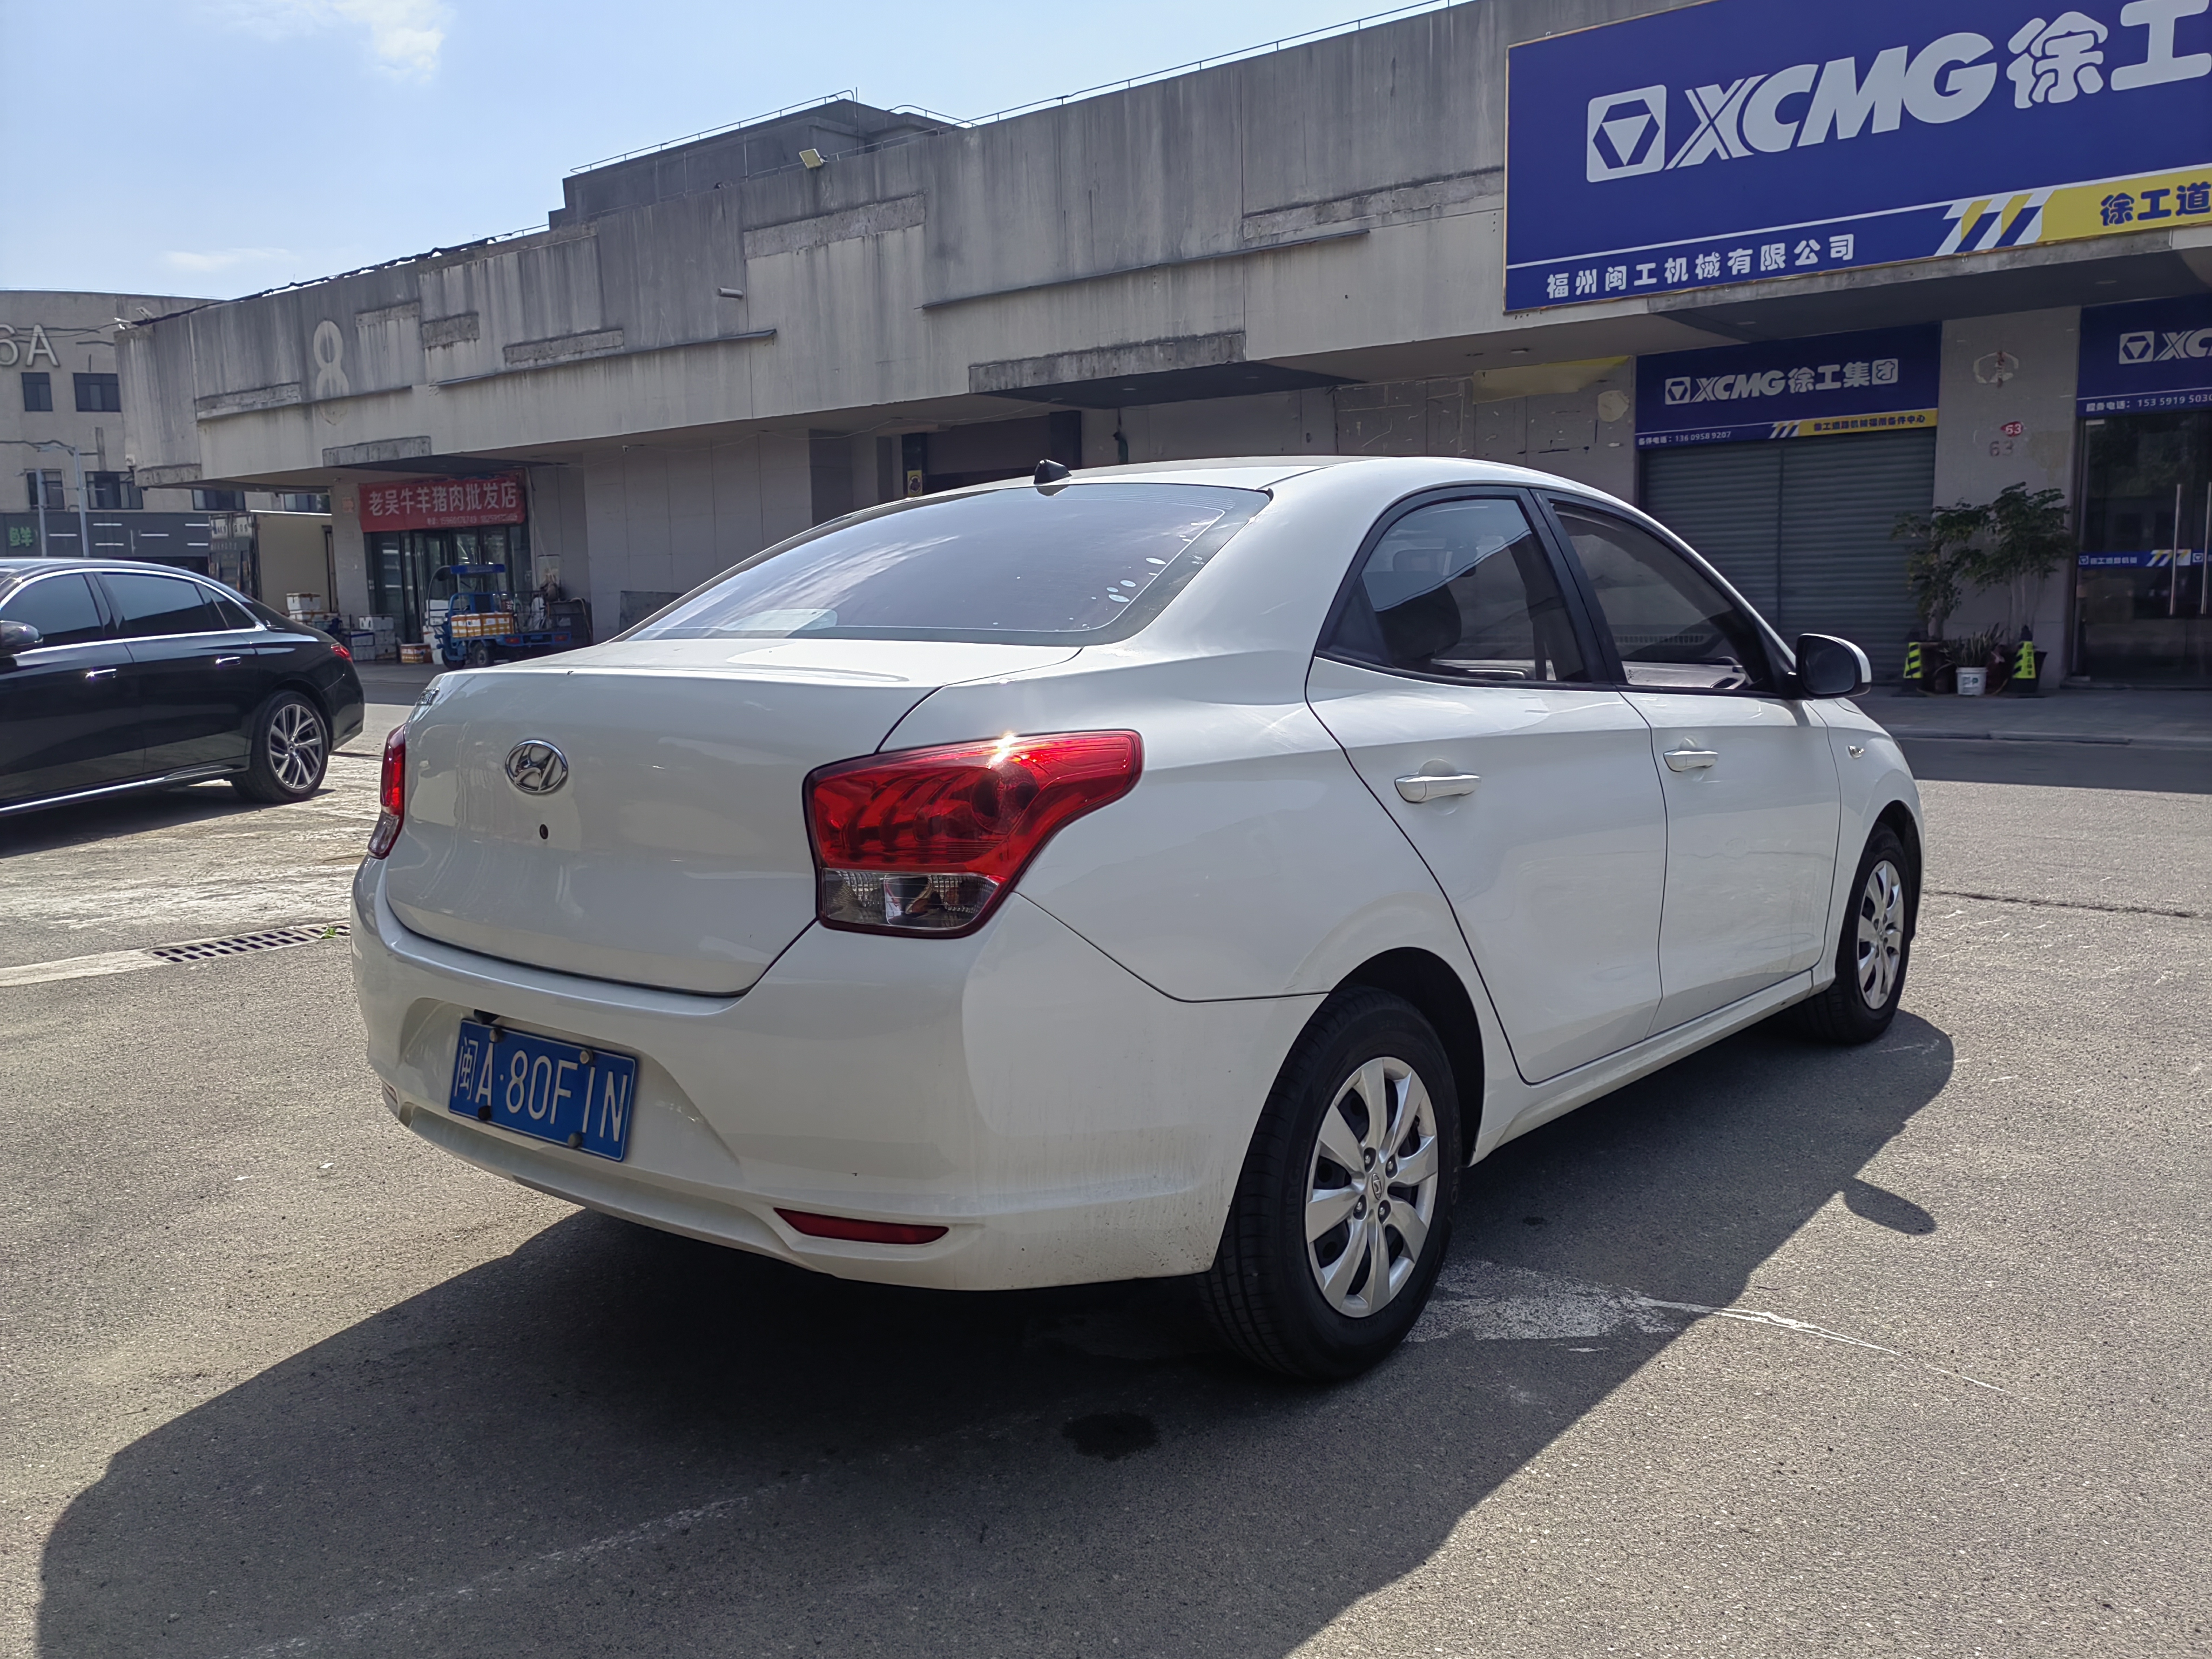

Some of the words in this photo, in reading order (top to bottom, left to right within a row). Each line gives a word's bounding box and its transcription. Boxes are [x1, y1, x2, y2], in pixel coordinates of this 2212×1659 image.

[1664, 32, 1997, 171] XCMG
[2006, 0, 2212, 109] 徐工
[2100, 181, 2212, 226] 徐工道
[1546, 233, 1854, 299] 福州闽工机械有限公司
[2153, 327, 2212, 362] XC
[1690, 369, 1786, 403] XCMG
[1787, 358, 1899, 394] 徐工集团
[2137, 398, 2156, 407] 153
[2005, 423, 2021, 435] 63
[368, 482, 517, 517] 老吴牛羊猪肉批发店
